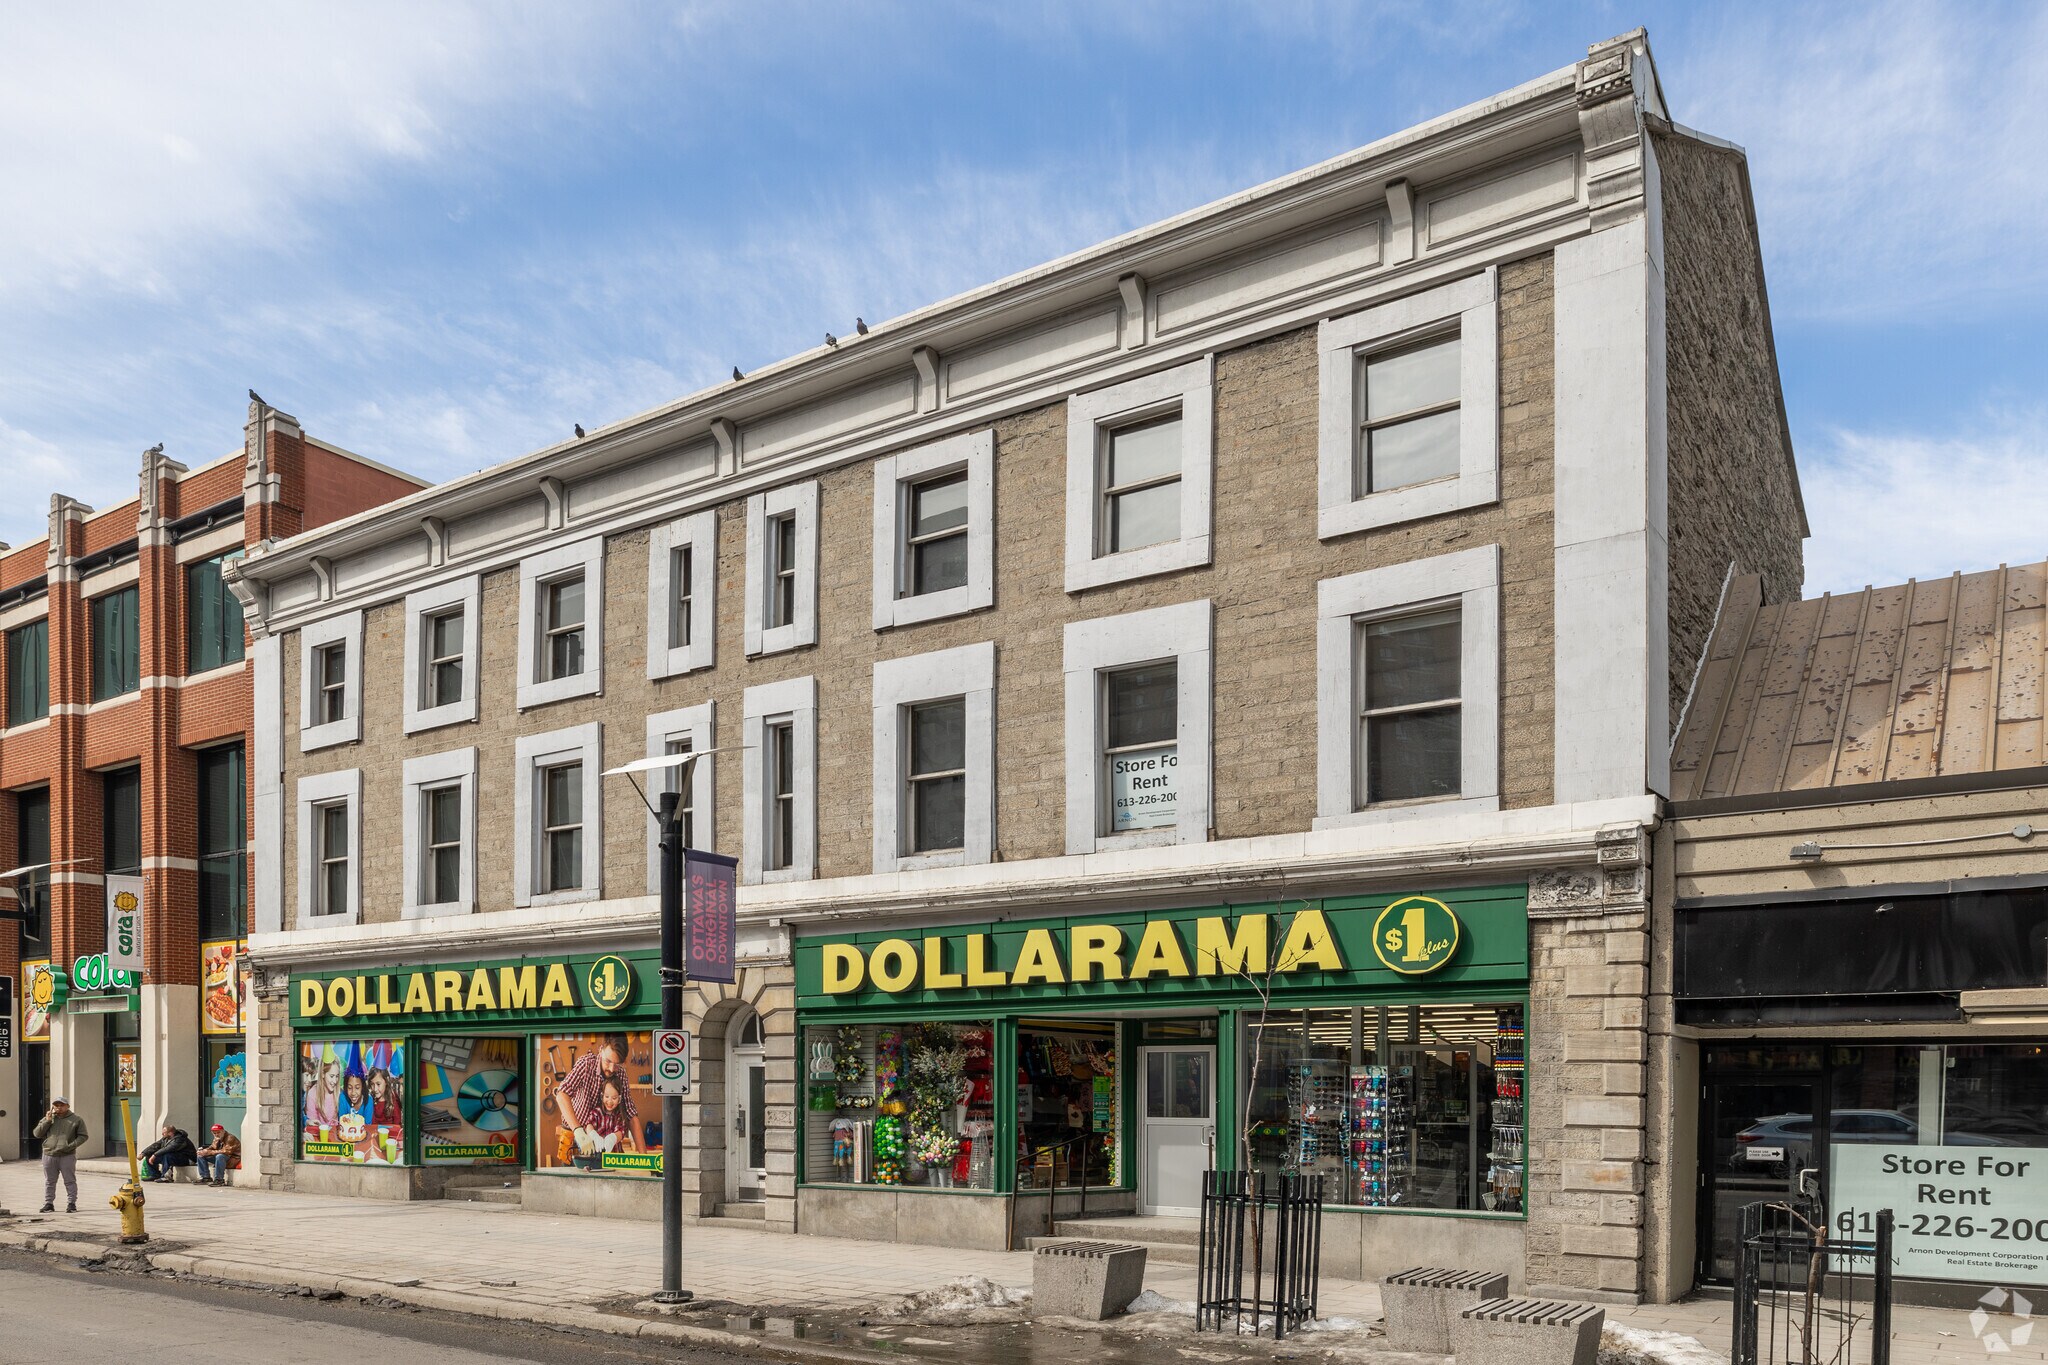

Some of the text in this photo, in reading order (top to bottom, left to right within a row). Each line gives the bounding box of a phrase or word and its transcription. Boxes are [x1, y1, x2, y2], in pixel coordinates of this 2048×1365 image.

[1115, 759, 1156, 774] Store
[1133, 774, 1168, 790] Rent
[692, 875, 704, 960] OTTAWA'S
[706, 879, 717, 962] ORIGINAL
[719, 880, 728, 964] DOWNTOWN
[118, 915, 134, 956] cora
[1385, 908, 1450, 962] $1 plus
[822, 910, 1345, 994] DOLLARAMA
[300, 963, 575, 1018] DOLLARAMA
[594, 963, 616, 1001] $1
[307, 1144, 340, 1153] DOLLARAMA
[428, 1147, 489, 1156] DOLLARAMA
[605, 1156, 651, 1166] DOLLARAMA
[1882, 1154, 2030, 1177] Store For
[1918, 1184, 1991, 1206] Rent
[1837, 1211, 2048, 1243] 61-226-200
[1836, 1254, 1900, 1266] ARNN
[1908, 1247, 1933, 1255] Arnon
[1935, 1248, 1991, 1258] Development
[1992, 1251, 2044, 1261] Corporation
[1967, 1259, 1993, 1267] Estate
[1995, 1260, 2038, 1270] Brokerage
